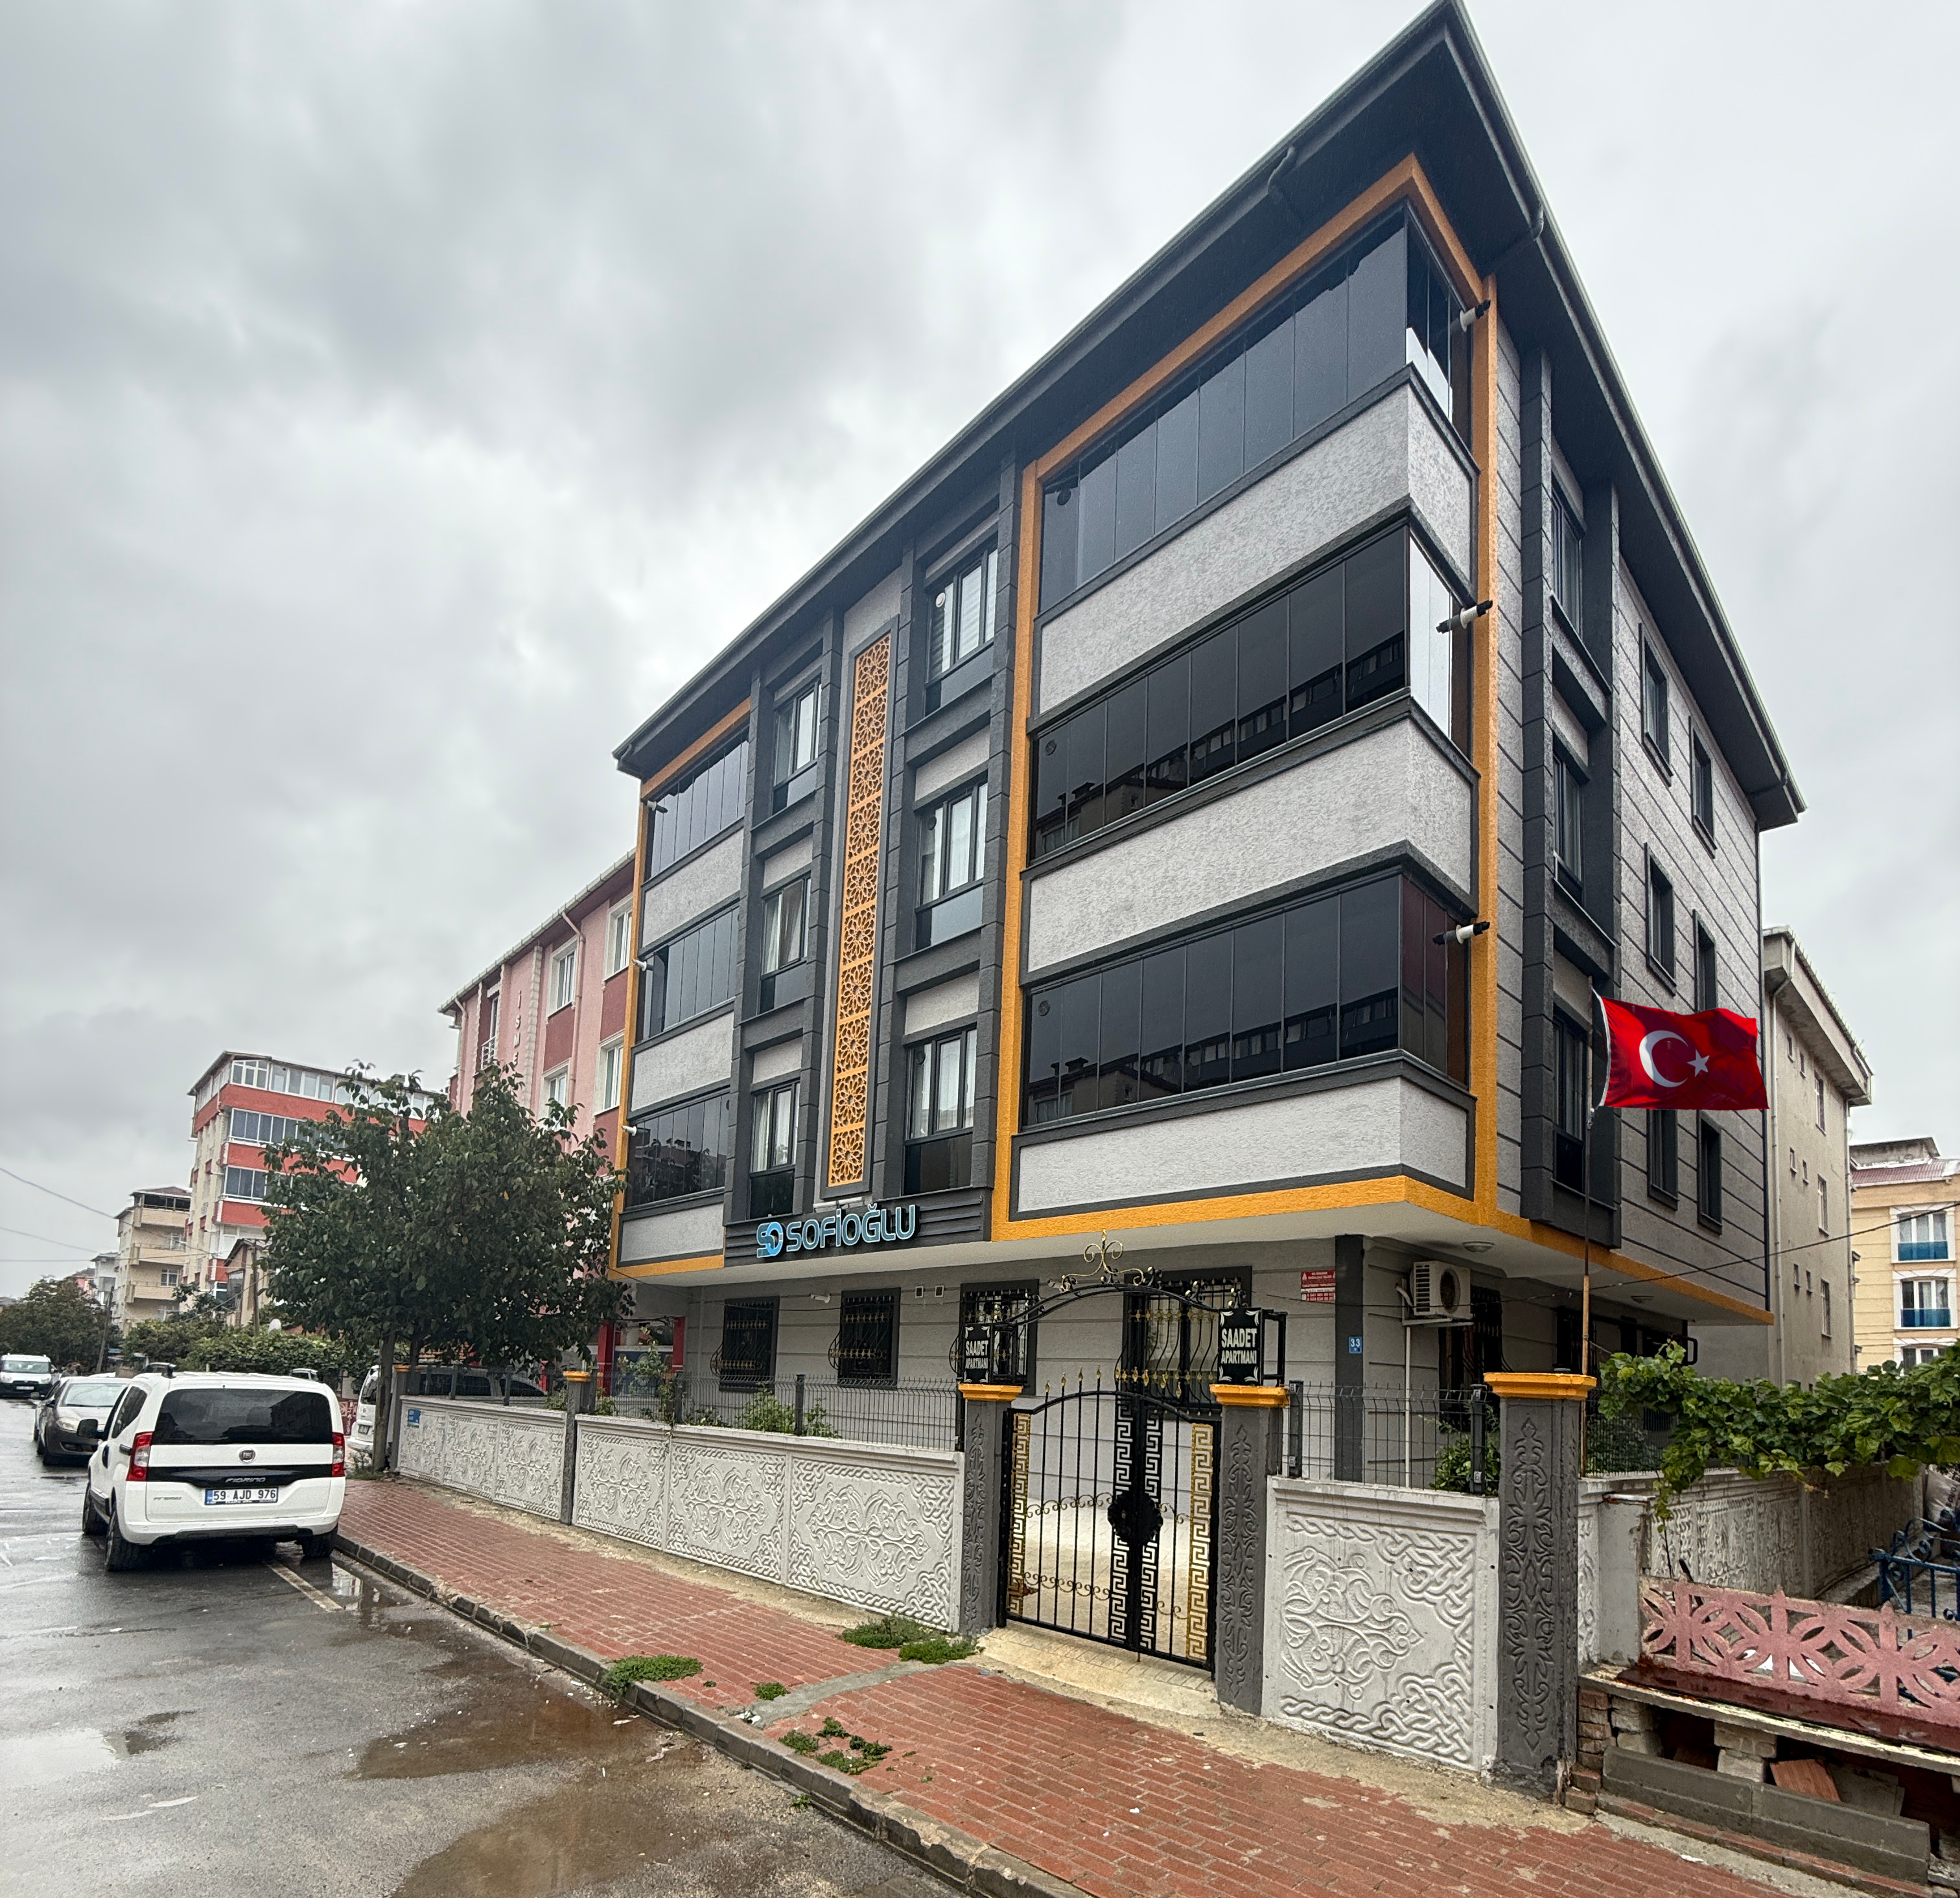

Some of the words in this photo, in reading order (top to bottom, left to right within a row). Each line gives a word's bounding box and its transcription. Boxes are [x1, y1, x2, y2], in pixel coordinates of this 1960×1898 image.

[786, 1203, 916, 1252] SOFİOĞLU
[1221, 1328, 1257, 1348] SAADET
[1350, 1338, 1360, 1347] 33
[965, 1340, 989, 1356] SAADET
[1220, 1350, 1257, 1364] APARTMANI
[213, 1490, 226, 1501] 59
[233, 1490, 251, 1500] AJD
[258, 1489, 276, 1499] 976
